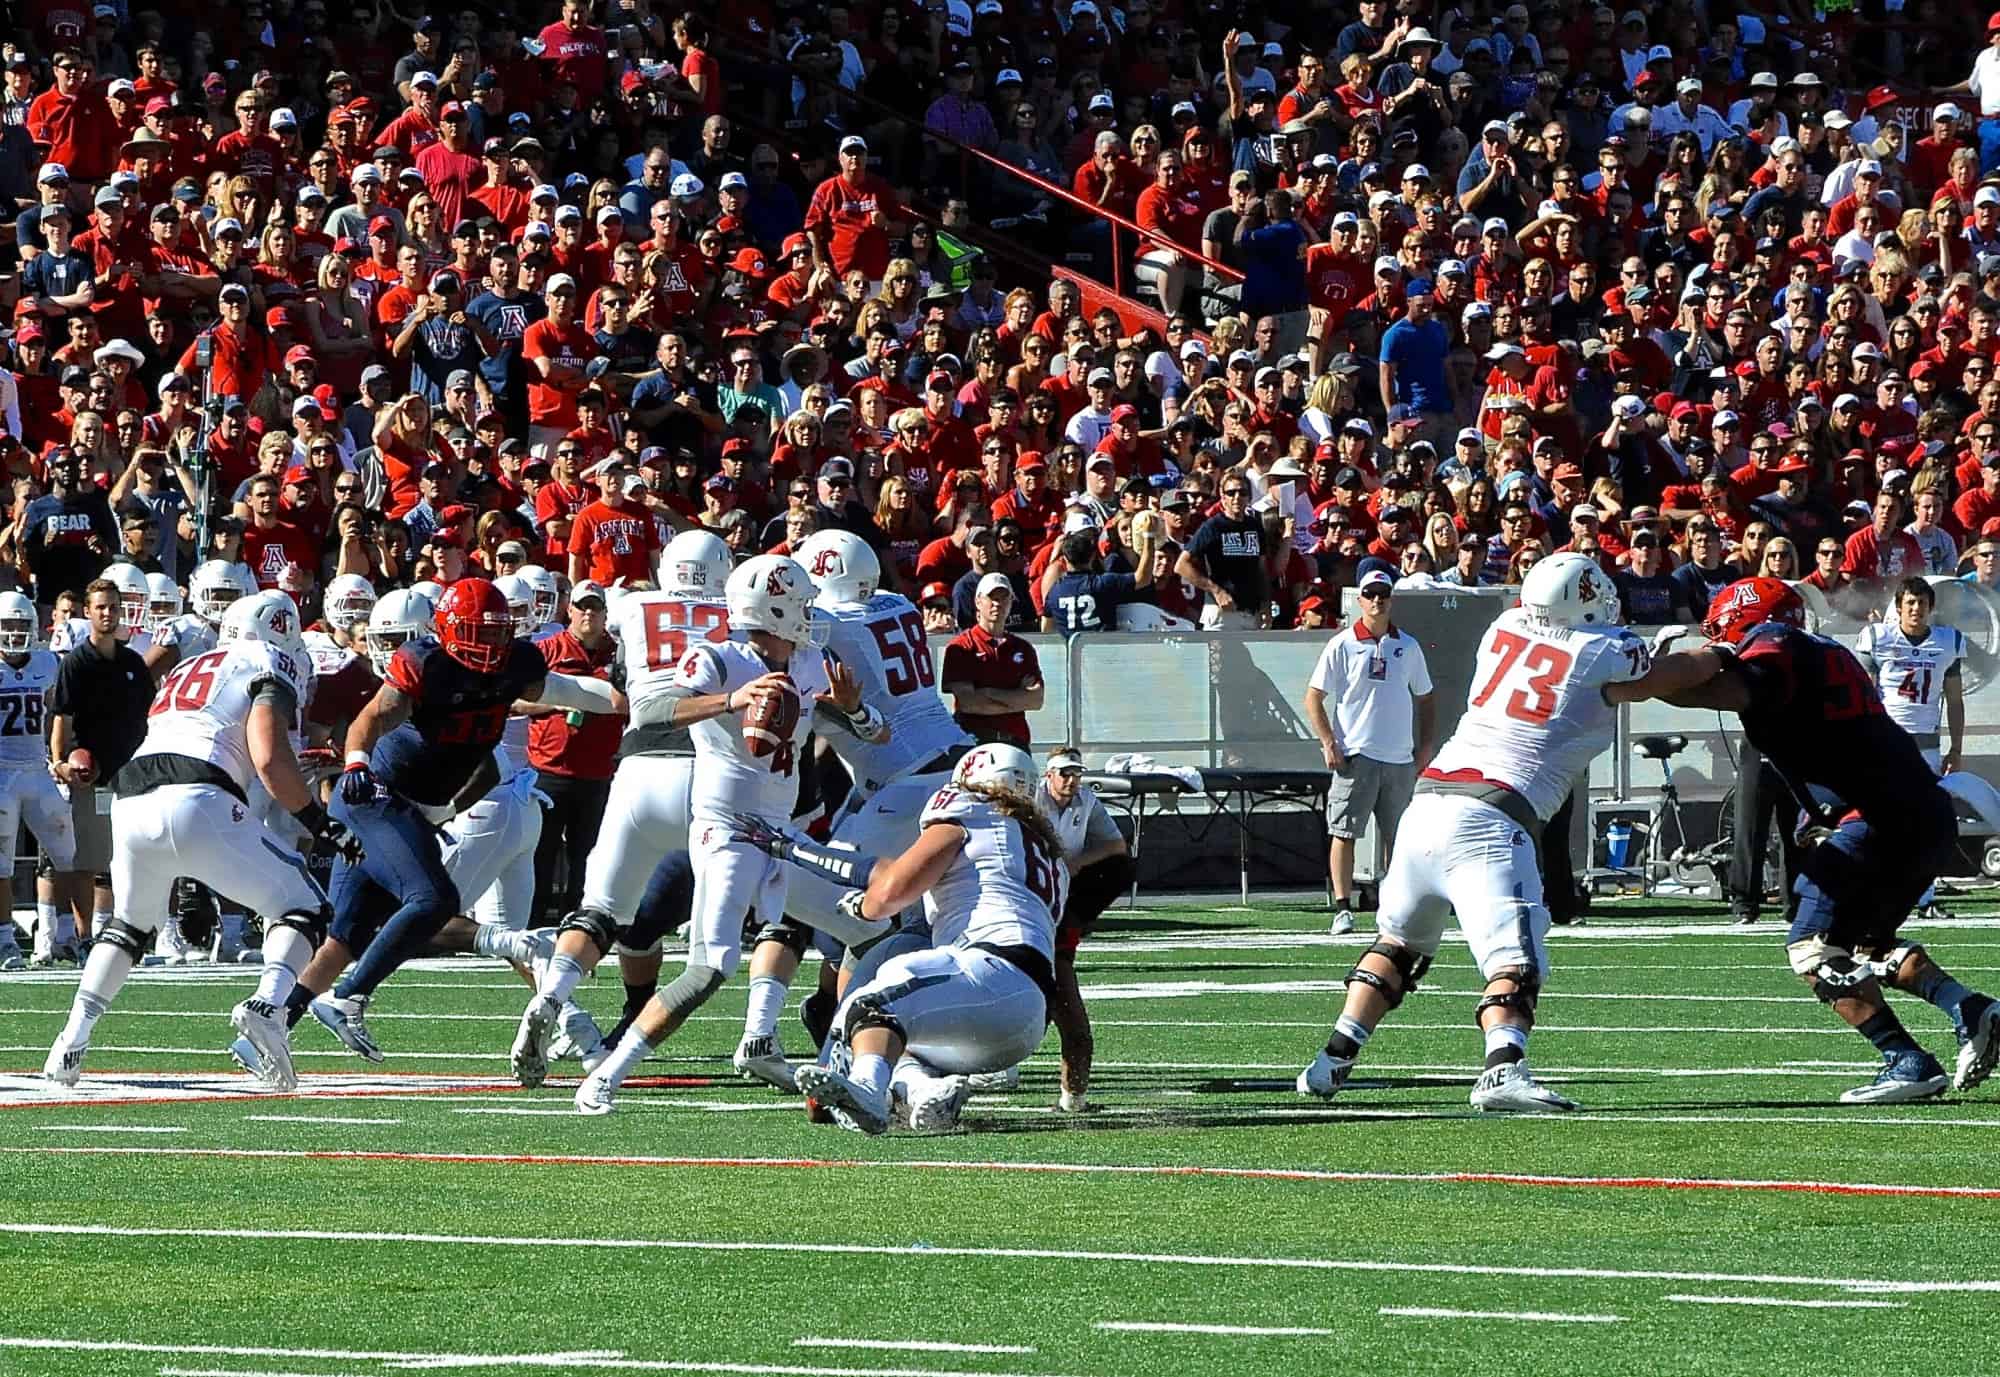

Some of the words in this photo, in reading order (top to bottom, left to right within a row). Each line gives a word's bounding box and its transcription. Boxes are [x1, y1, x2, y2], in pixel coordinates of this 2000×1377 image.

[499, 306, 528, 341] A
[48, 514, 91, 531] BEAR
[263, 544, 291, 574] A
[1058, 594, 1101, 629] 72
[1732, 583, 1760, 608] A
[683, 652, 700, 678] 4
[864, 610, 935, 696] 58
[149, 651, 229, 716] 56
[1471, 629, 1573, 726] 73
[1898, 667, 1932, 704] 41
[242, 999, 278, 1019] NIKE
[743, 1036, 774, 1059] NIKE
